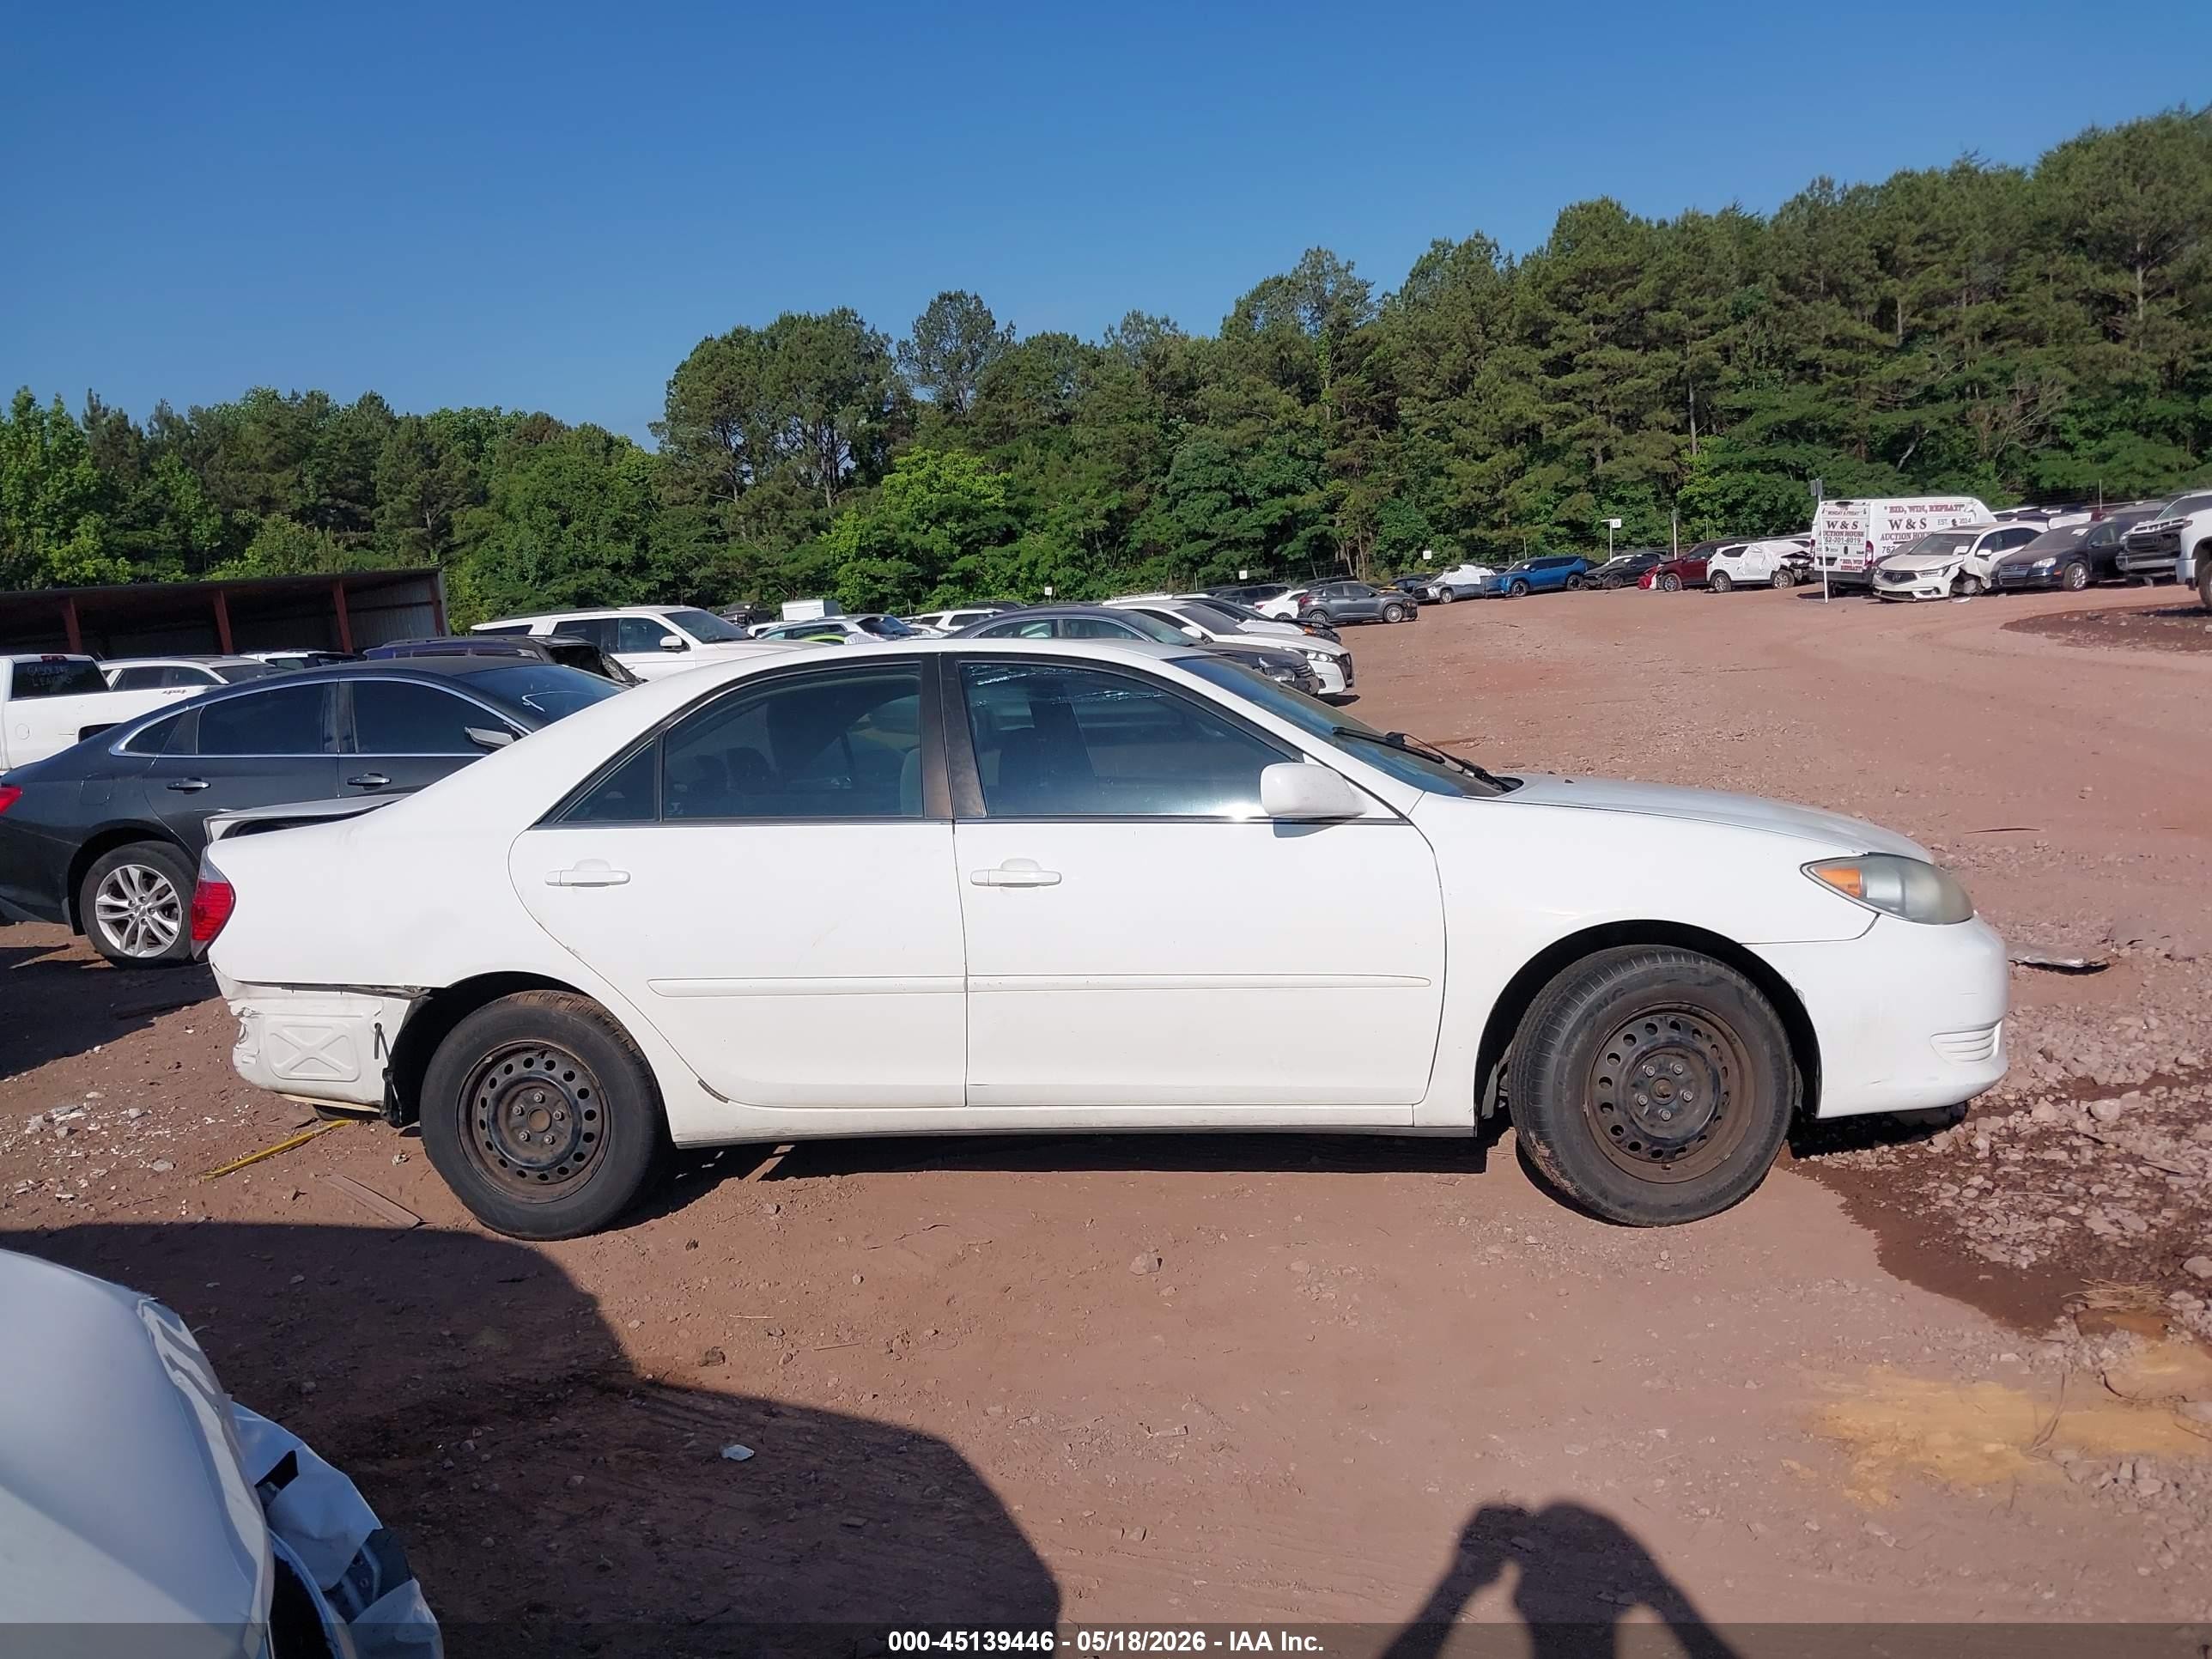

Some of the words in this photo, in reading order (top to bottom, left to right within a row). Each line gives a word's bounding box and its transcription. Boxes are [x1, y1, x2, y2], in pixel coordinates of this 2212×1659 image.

[1826, 520, 1838, 529] W
[1840, 520, 1850, 530] &
[1851, 520, 1859, 530] S
[1888, 519, 1903, 530] W
[1905, 518, 1916, 530] &
[1919, 517, 1928, 529] S
[1880, 532, 1911, 541] AUCTION
